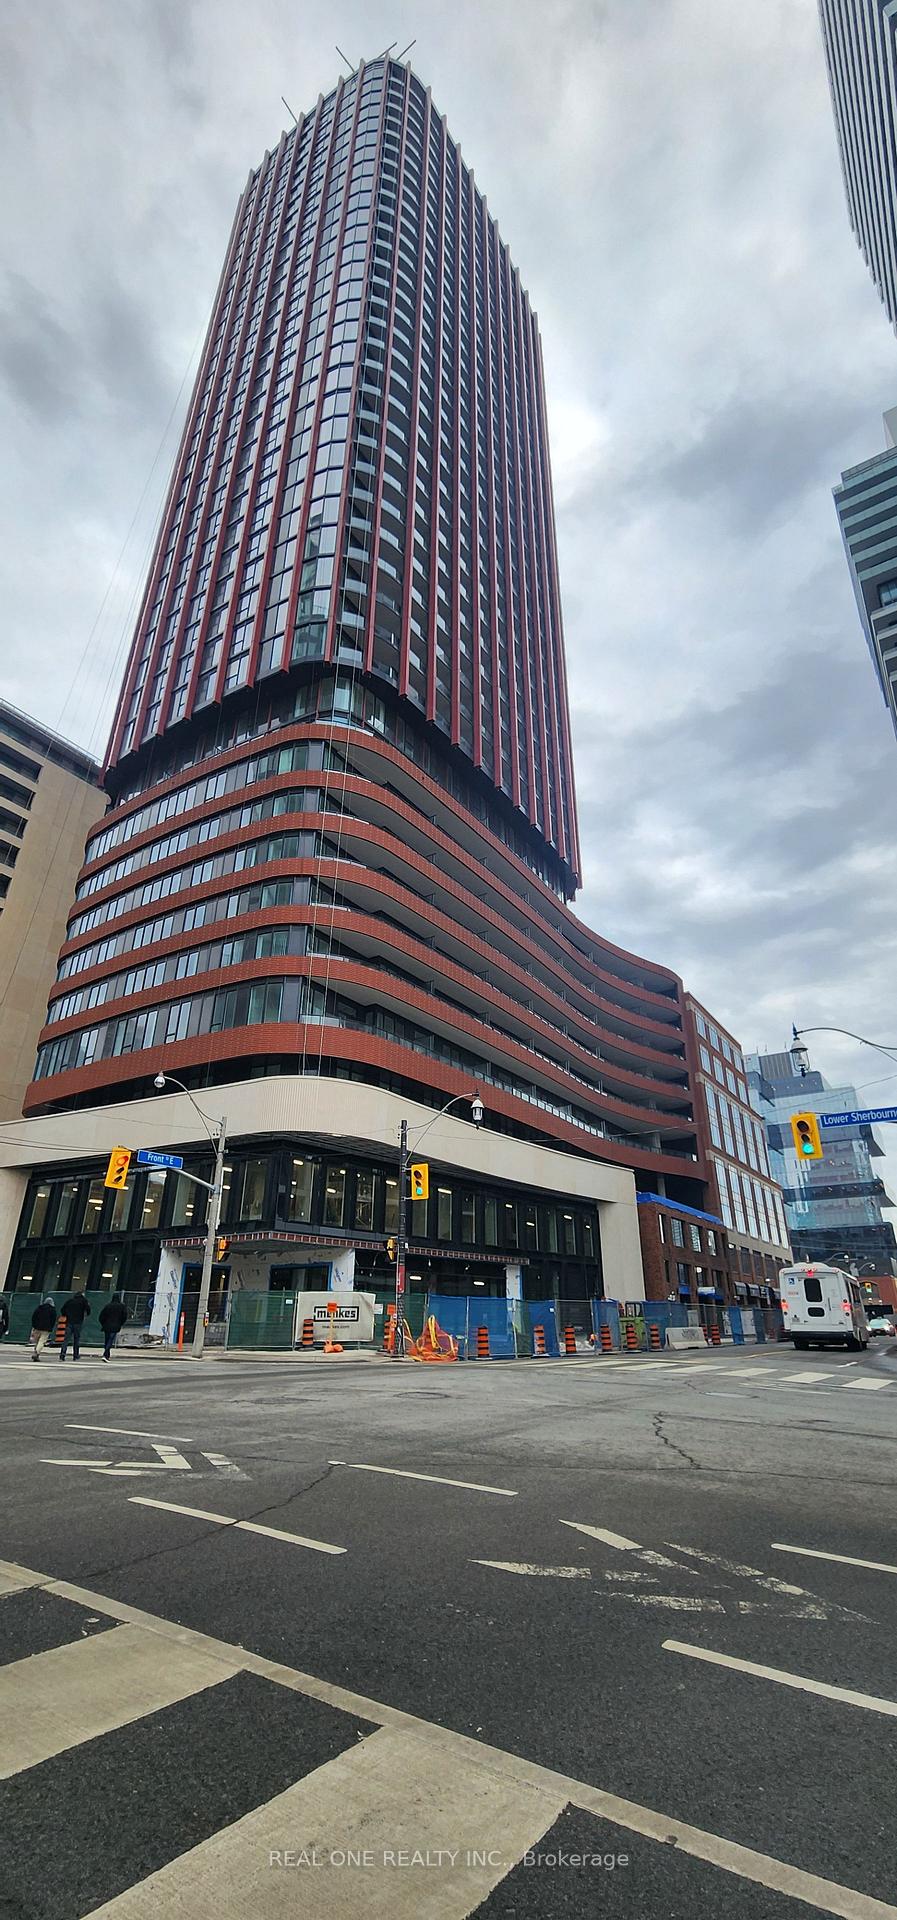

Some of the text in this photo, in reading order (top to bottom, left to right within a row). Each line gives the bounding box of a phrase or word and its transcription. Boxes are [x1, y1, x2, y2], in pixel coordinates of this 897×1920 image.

[823, 1110, 897, 1125] Lower Sherbourn
[147, 1153, 164, 1163] Front
